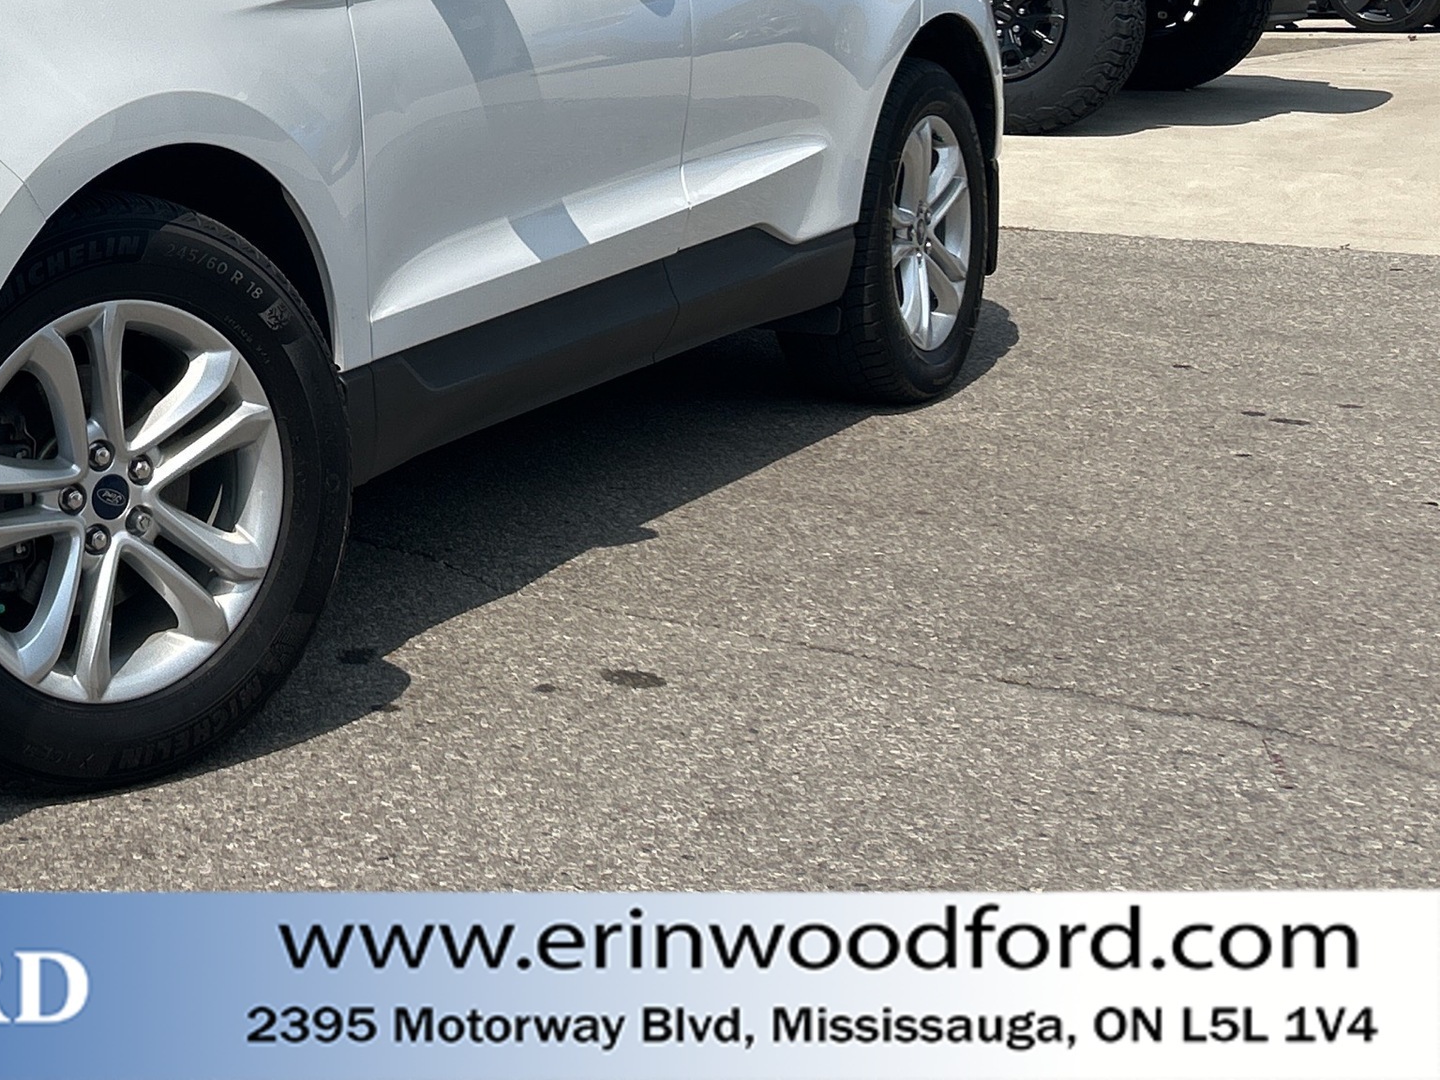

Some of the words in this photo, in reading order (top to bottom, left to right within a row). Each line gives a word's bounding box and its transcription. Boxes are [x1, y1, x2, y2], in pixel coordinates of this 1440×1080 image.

[166, 242, 228, 276] 245/60
[229, 268, 245, 286] R
[246, 280, 264, 300] 18
